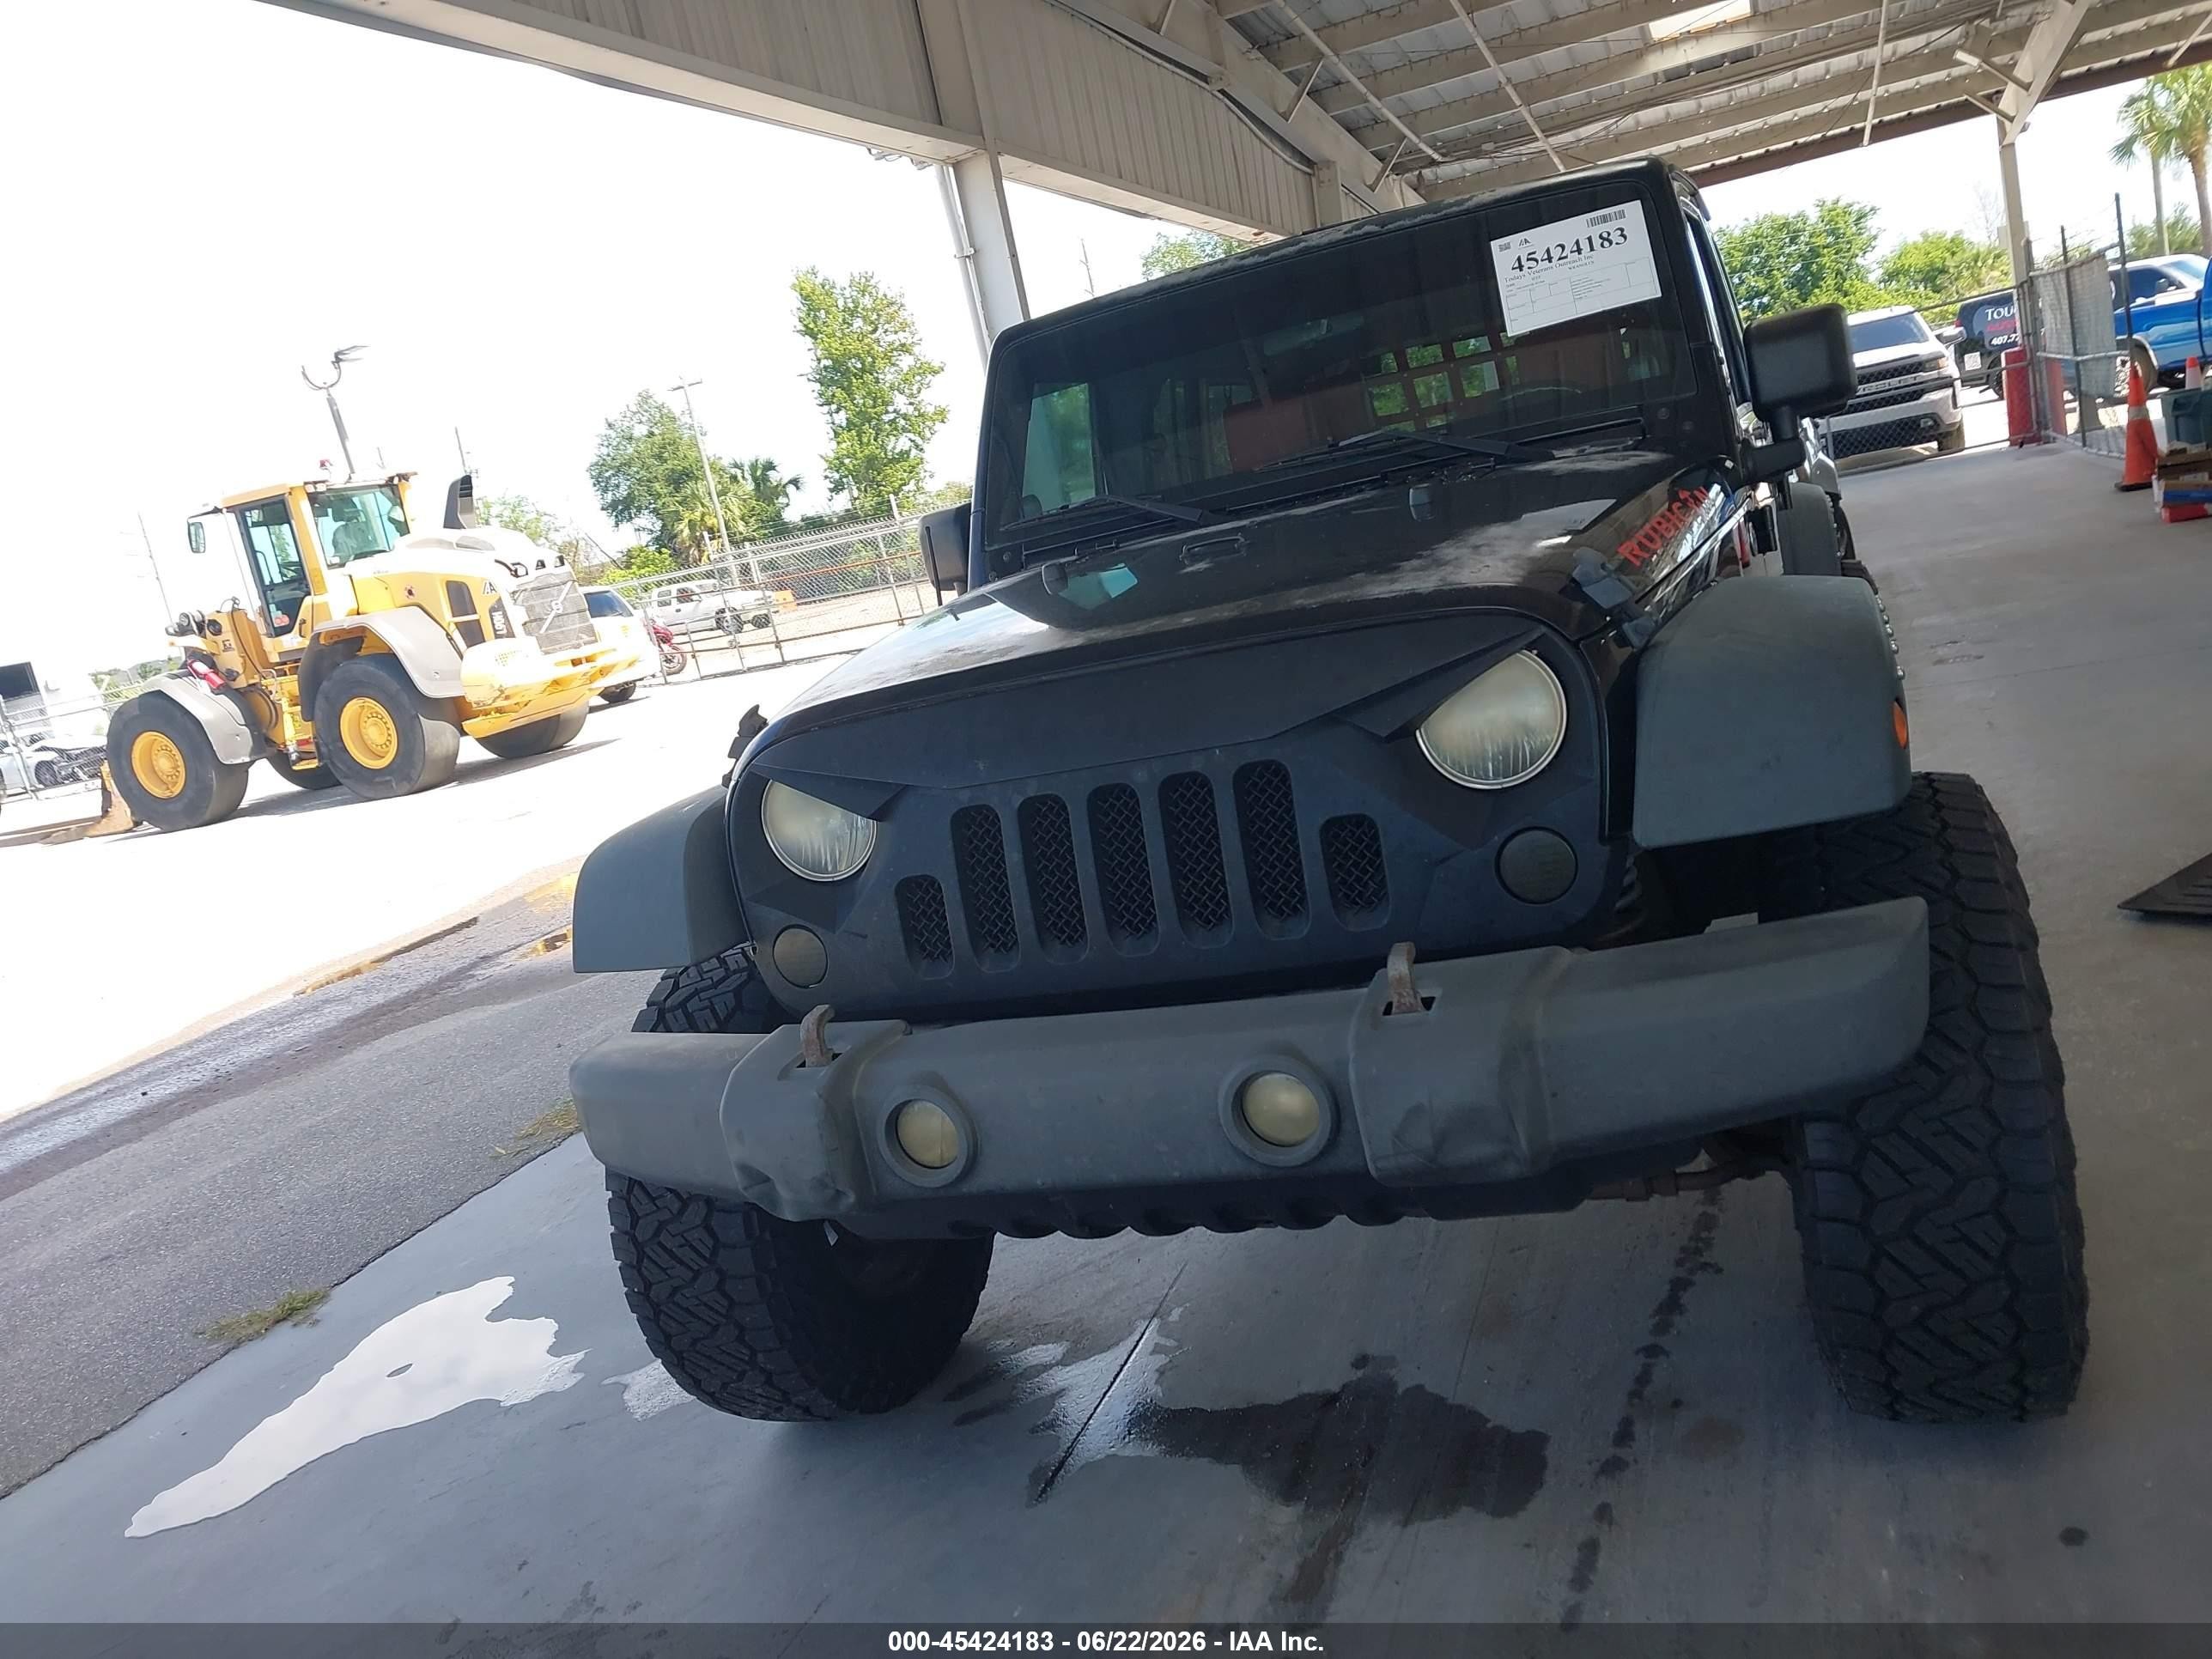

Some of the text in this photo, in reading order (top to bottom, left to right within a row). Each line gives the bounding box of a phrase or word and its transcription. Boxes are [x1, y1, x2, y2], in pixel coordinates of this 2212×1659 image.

[1511, 227, 1628, 272] 45424183
[1528, 265, 1553, 276] Veterans
[1554, 258, 1583, 268] Outreach
[1984, 306, 2017, 321] TOU
